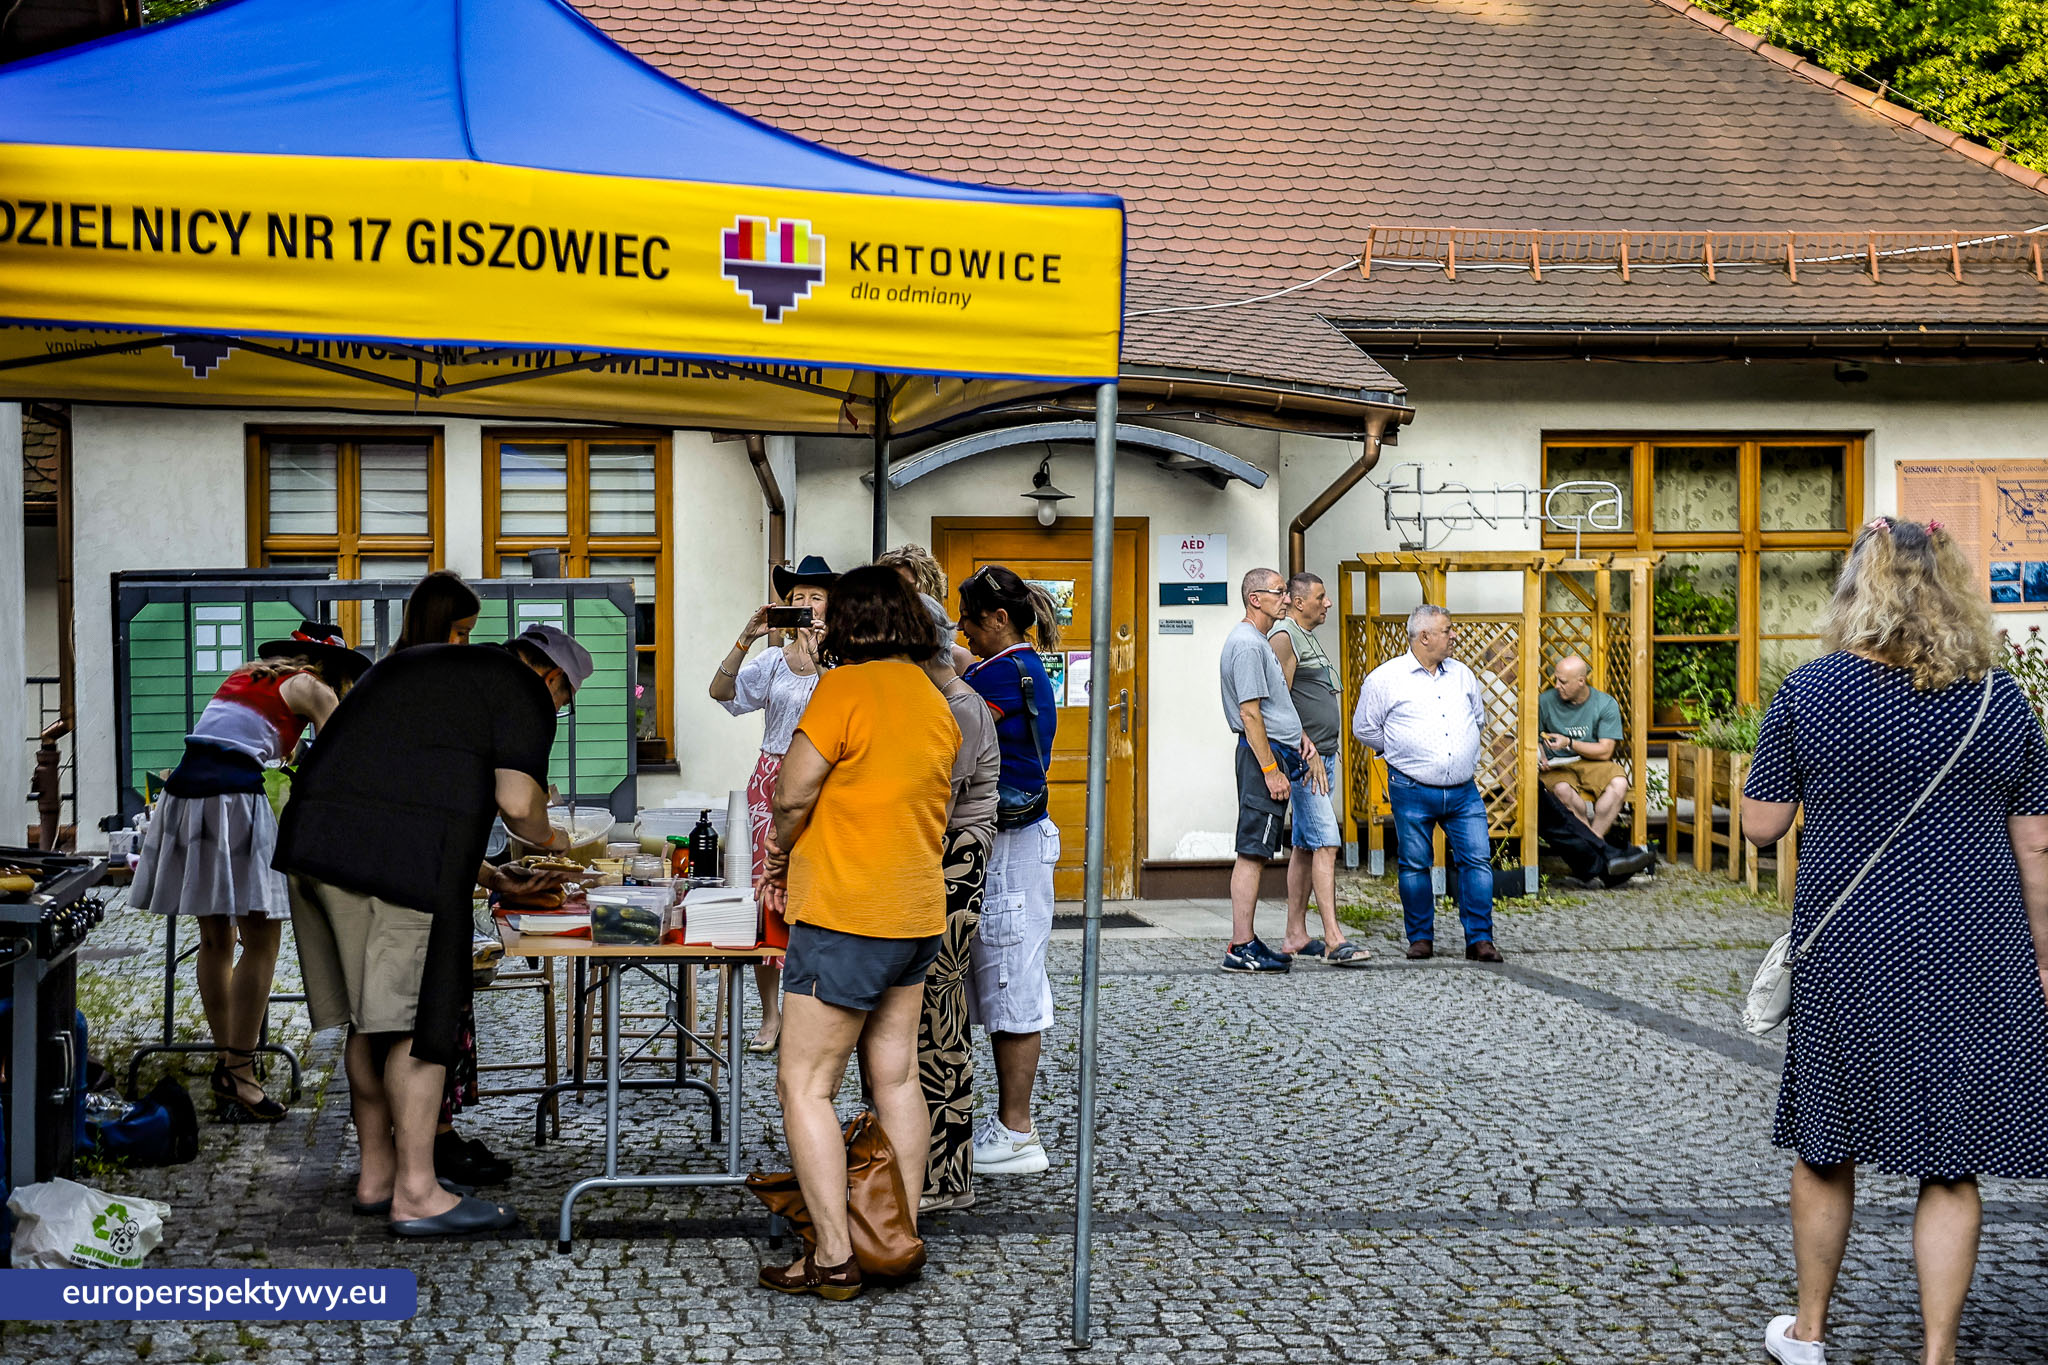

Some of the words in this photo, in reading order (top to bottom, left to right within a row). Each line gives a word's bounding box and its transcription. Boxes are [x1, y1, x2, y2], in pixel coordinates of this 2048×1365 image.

[267, 212, 334, 260] NR
[349, 217, 392, 262] 17
[406, 218, 671, 281] GISZOWIEC
[850, 240, 1062, 284] KATOWICE
[851, 281, 881, 301] dla
[886, 284, 973, 310] odmiany
[1181, 540, 1205, 550] AED
